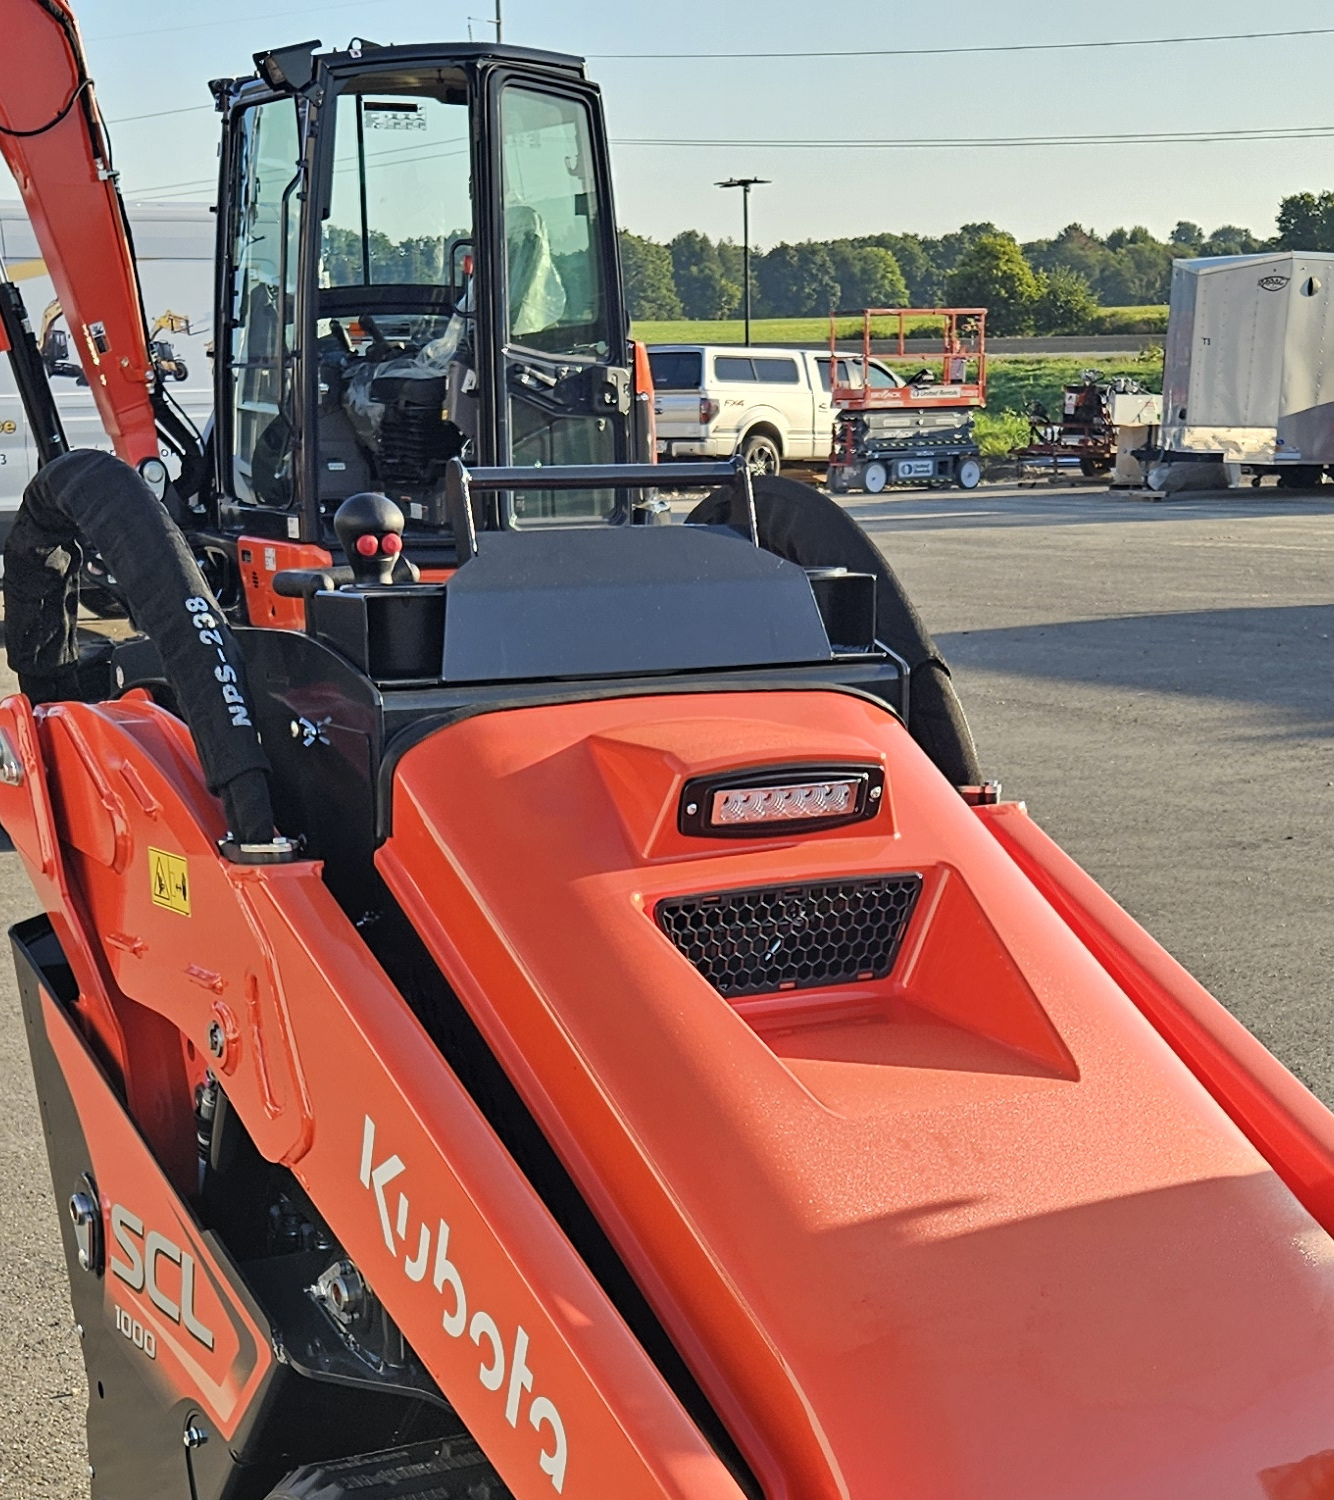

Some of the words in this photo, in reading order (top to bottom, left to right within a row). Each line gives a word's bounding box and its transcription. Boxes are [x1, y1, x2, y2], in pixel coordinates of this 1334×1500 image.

[724, 399, 744, 408] FX4
[185, 596, 252, 727] NPS-238
[110, 1203, 215, 1353] SCL
[115, 1304, 156, 1360] 1000
[359, 1113, 567, 1495] Kubota
